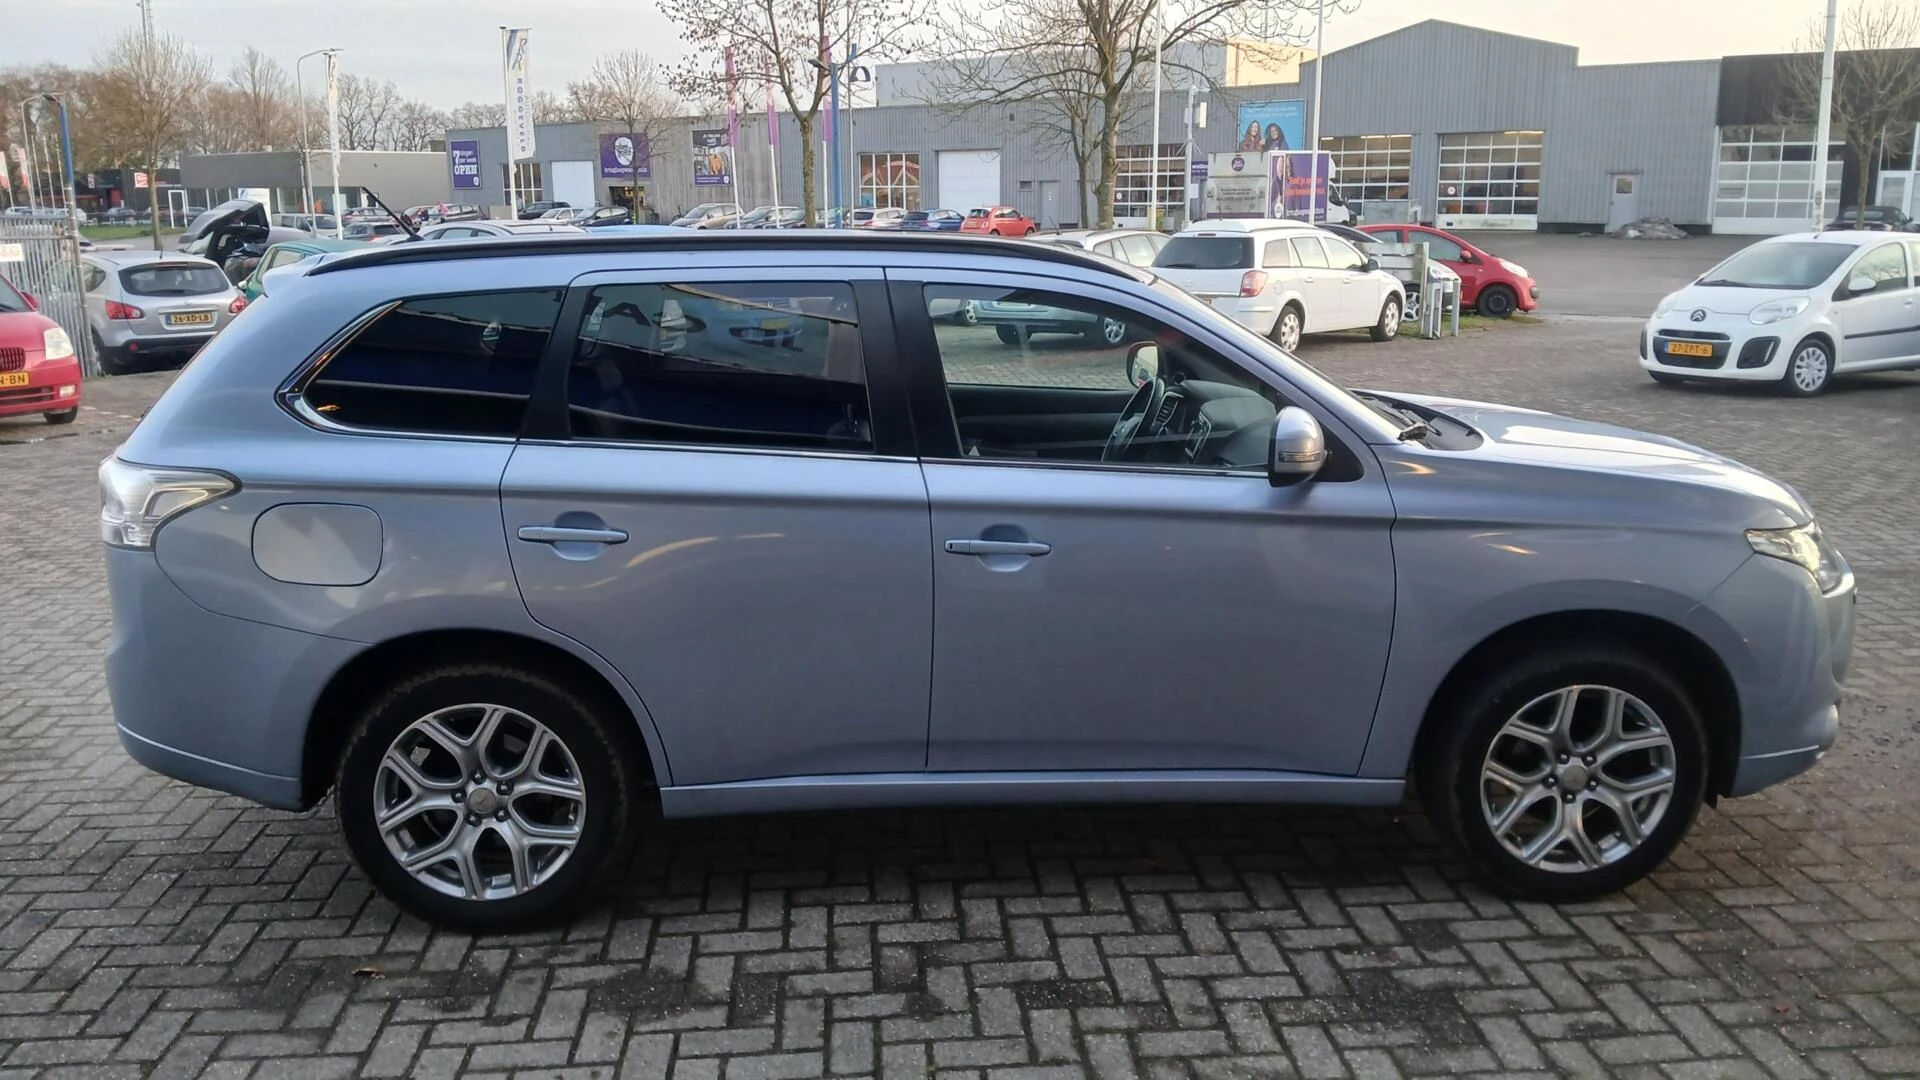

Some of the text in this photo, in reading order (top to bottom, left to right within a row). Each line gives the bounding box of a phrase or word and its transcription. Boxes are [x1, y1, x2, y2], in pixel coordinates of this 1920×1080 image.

[453, 150, 460, 165] 7
[454, 165, 478, 175] OPEN
[1672, 343, 1708, 355] 27-ZPT-6
